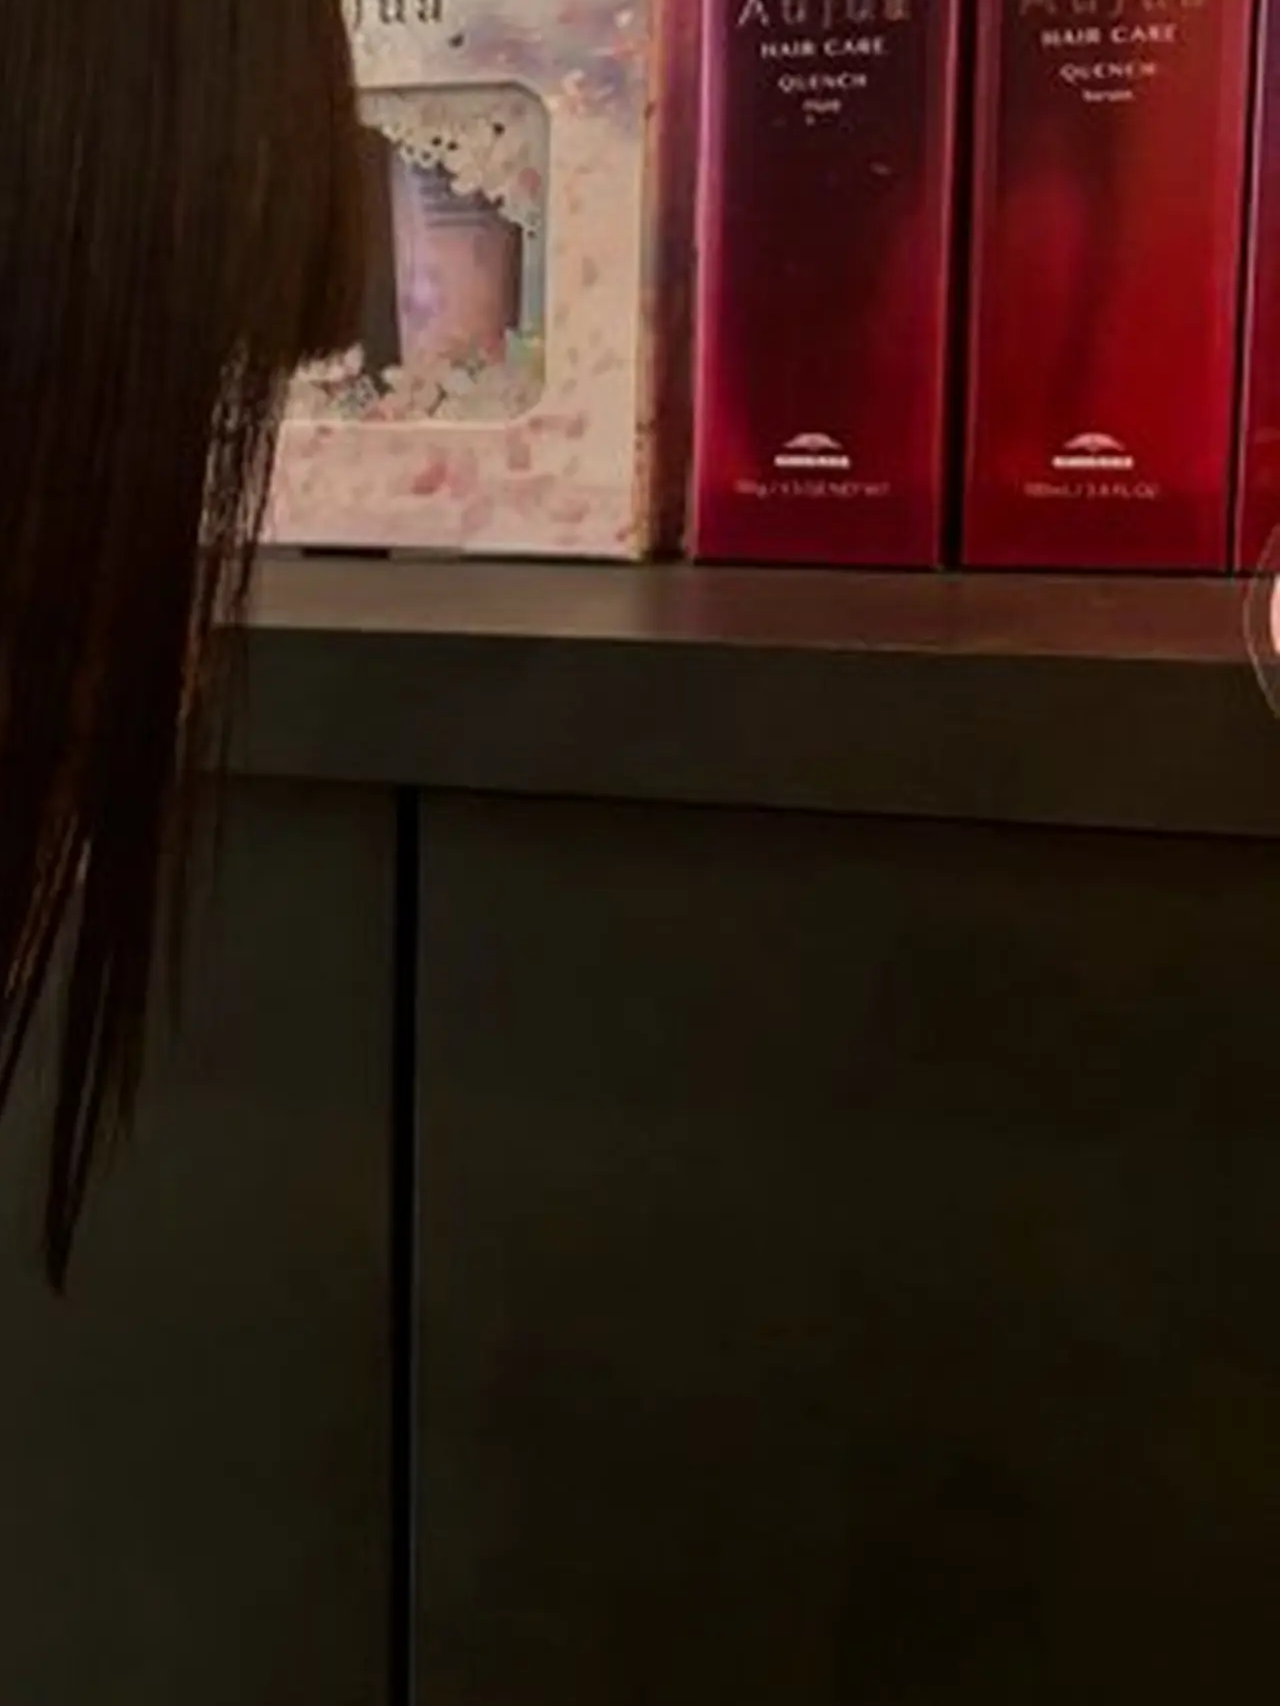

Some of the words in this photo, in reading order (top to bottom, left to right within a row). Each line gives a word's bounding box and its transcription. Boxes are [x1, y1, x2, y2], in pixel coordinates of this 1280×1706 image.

[1039, 26, 1103, 47] HAIR
[1109, 22, 1178, 44] CARE
[760, 38, 817, 59] HAIR
[823, 35, 886, 57] CARE
[777, 71, 868, 93] QUENCH
